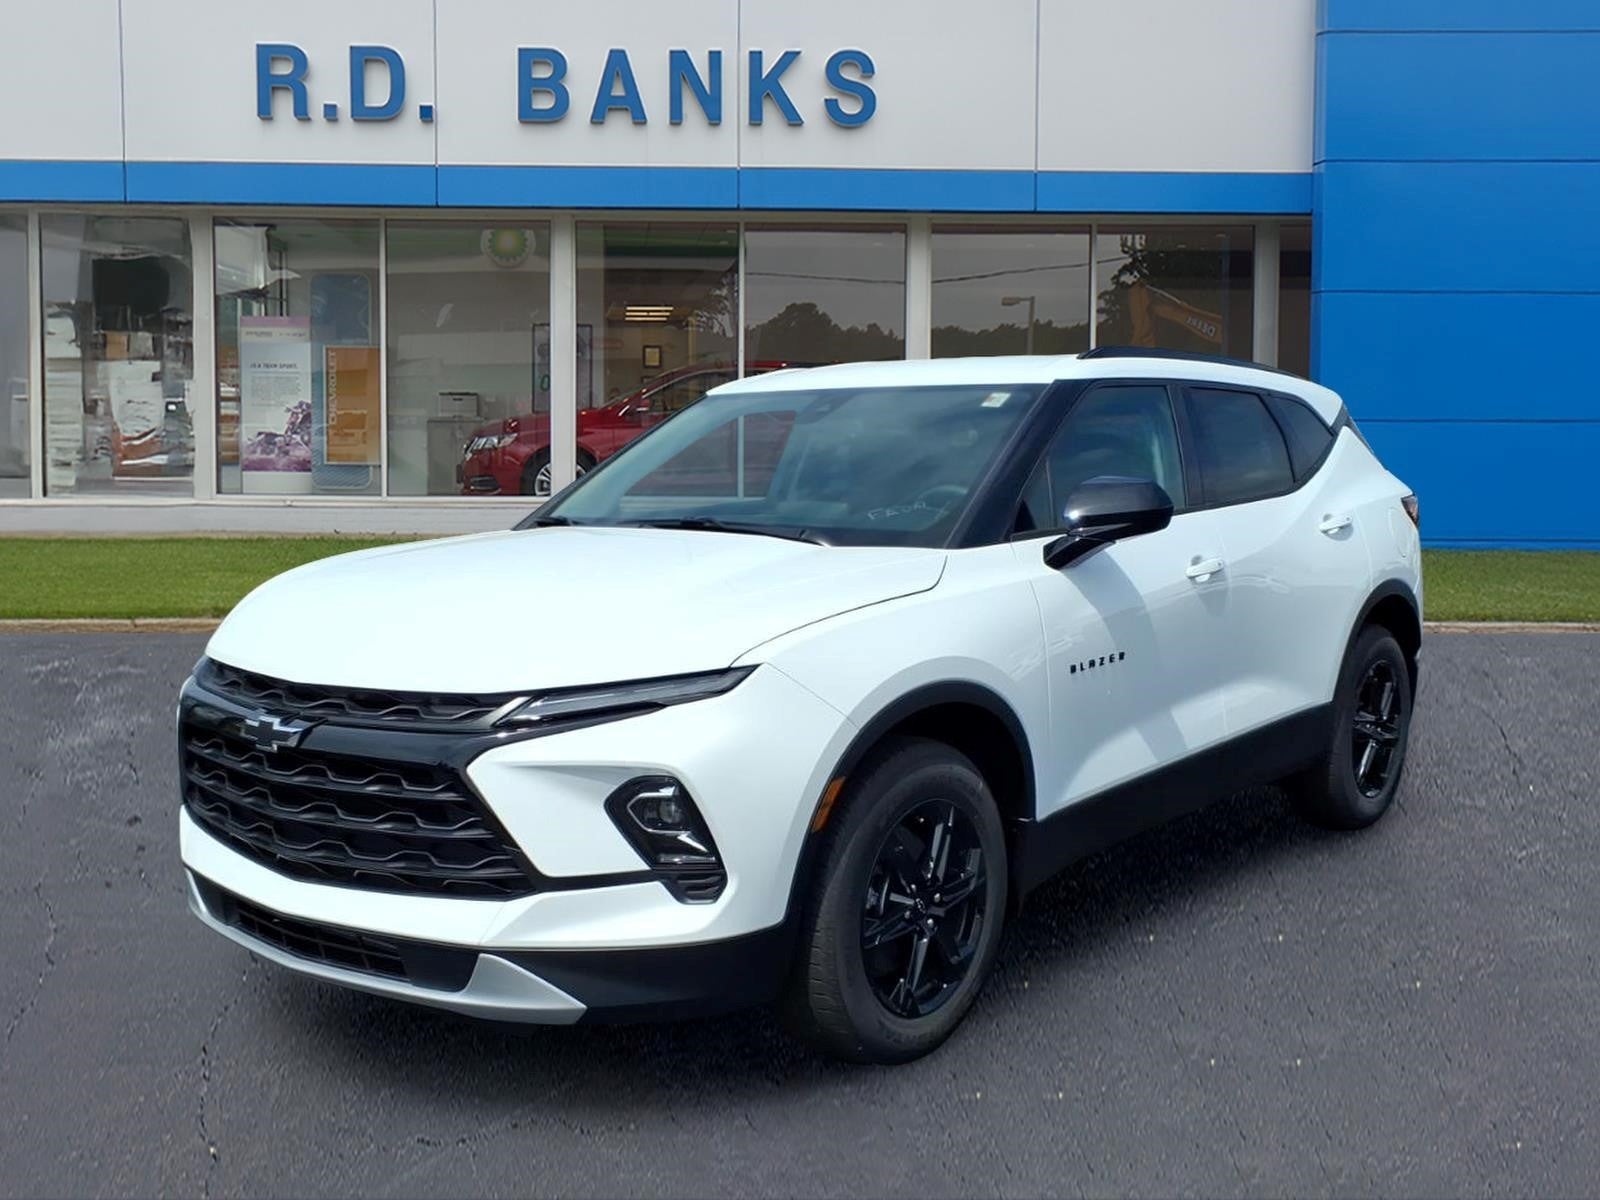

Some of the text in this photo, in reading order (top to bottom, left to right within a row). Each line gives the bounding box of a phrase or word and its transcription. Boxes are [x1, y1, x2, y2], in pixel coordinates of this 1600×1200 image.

[256, 42, 877, 128] R.D. BANKS
[1070, 652, 1125, 674] BLAZER
